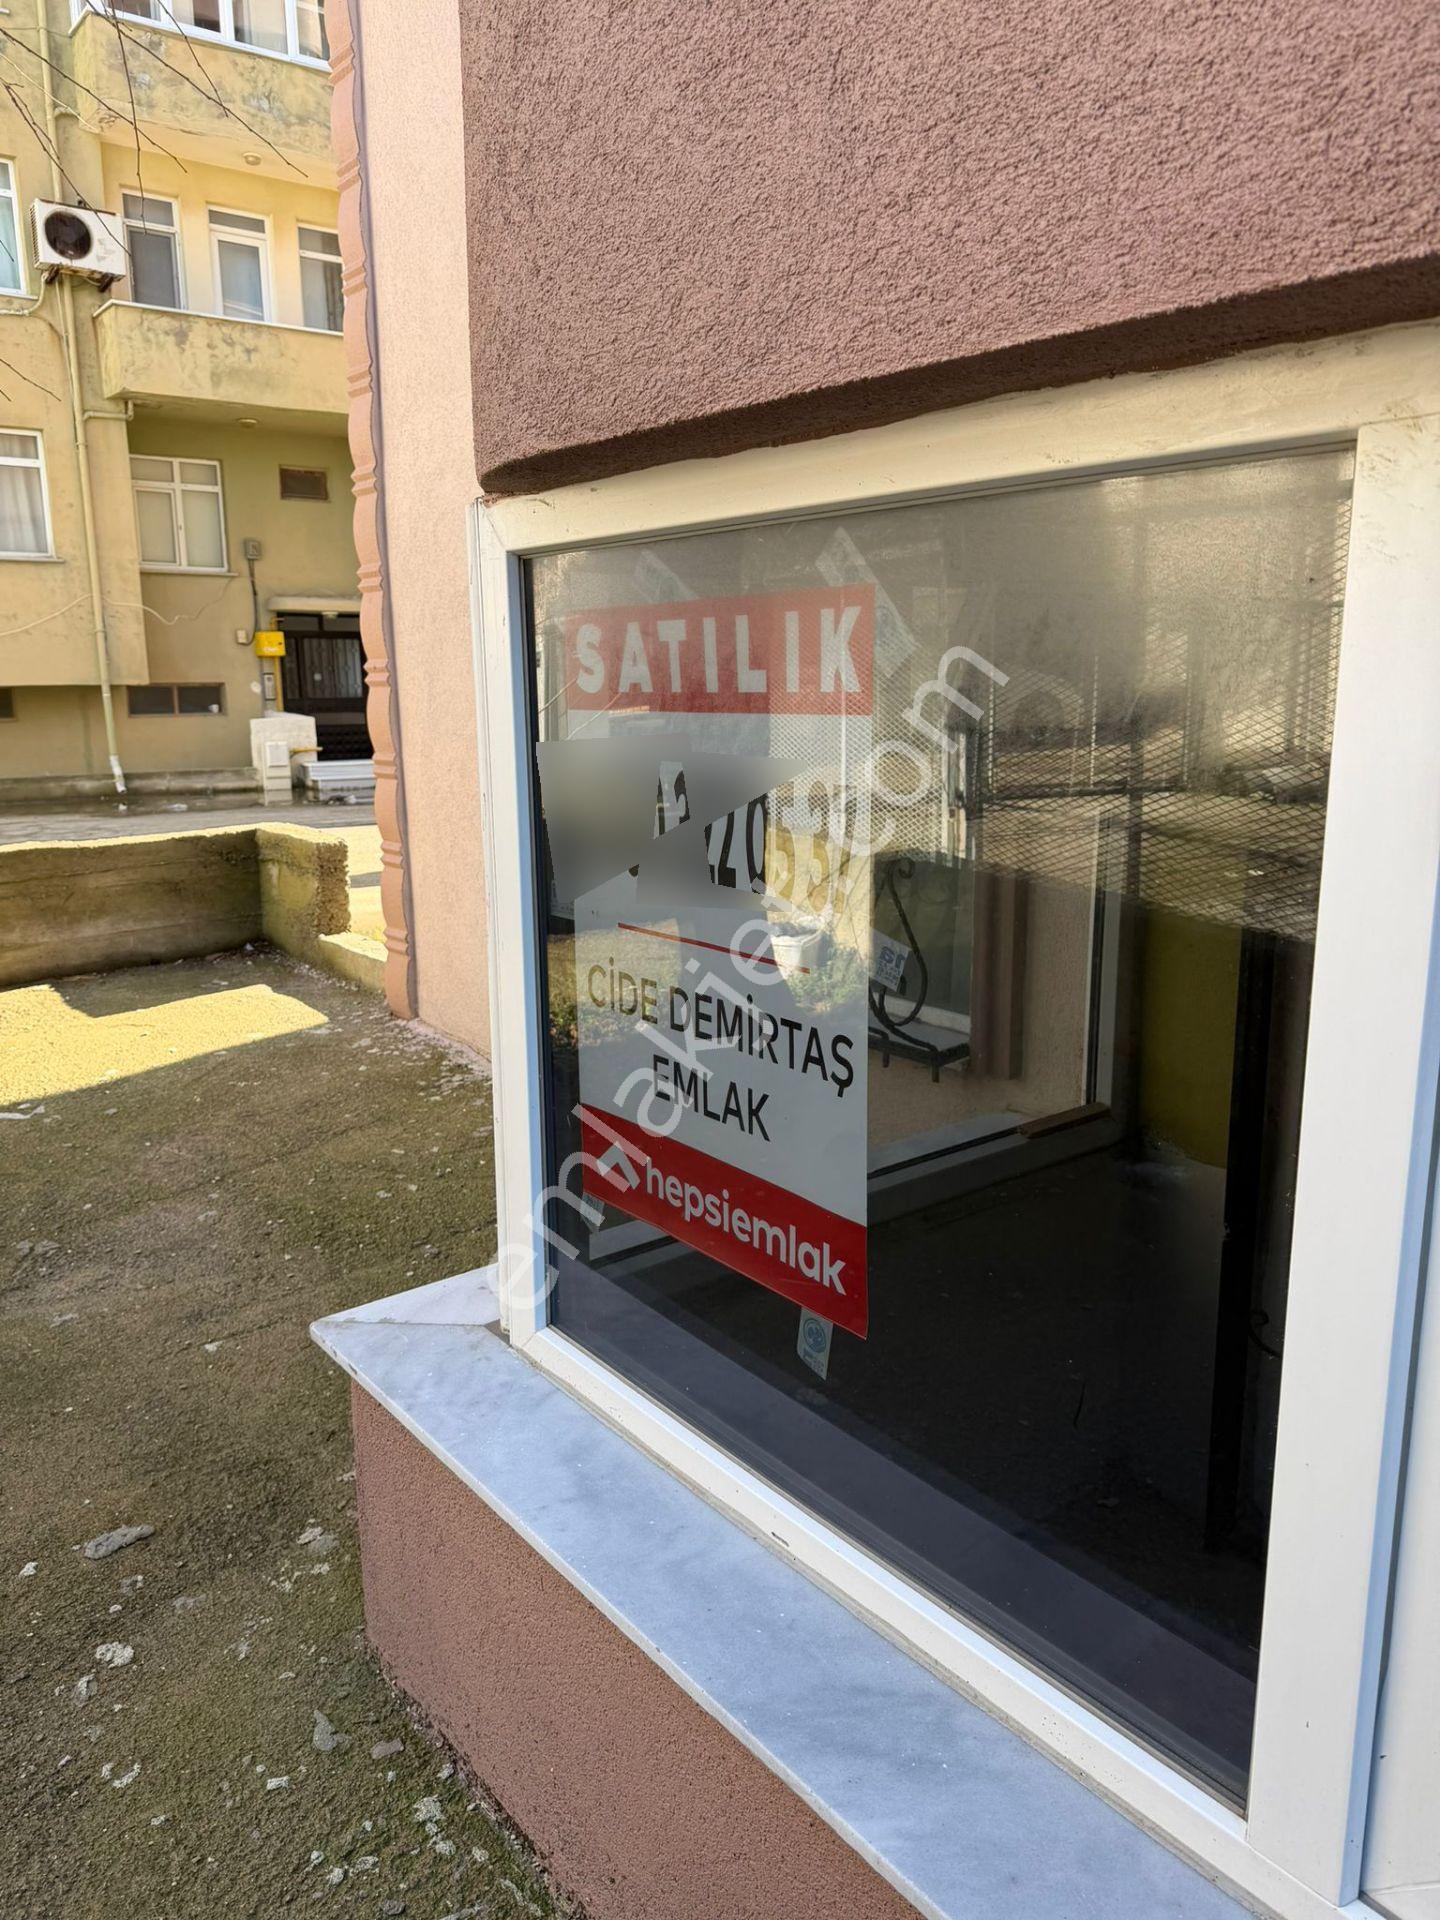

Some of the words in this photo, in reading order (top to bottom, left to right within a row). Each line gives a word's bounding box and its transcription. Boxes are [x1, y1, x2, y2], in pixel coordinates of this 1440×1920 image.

[575, 605, 862, 694] SATILIK
[587, 957, 658, 1025] CİDE
[669, 985, 854, 1098] DEMİRTAŞ
[652, 1053, 771, 1142] EMLAK
[646, 1156, 847, 1296] hepsiemlak
